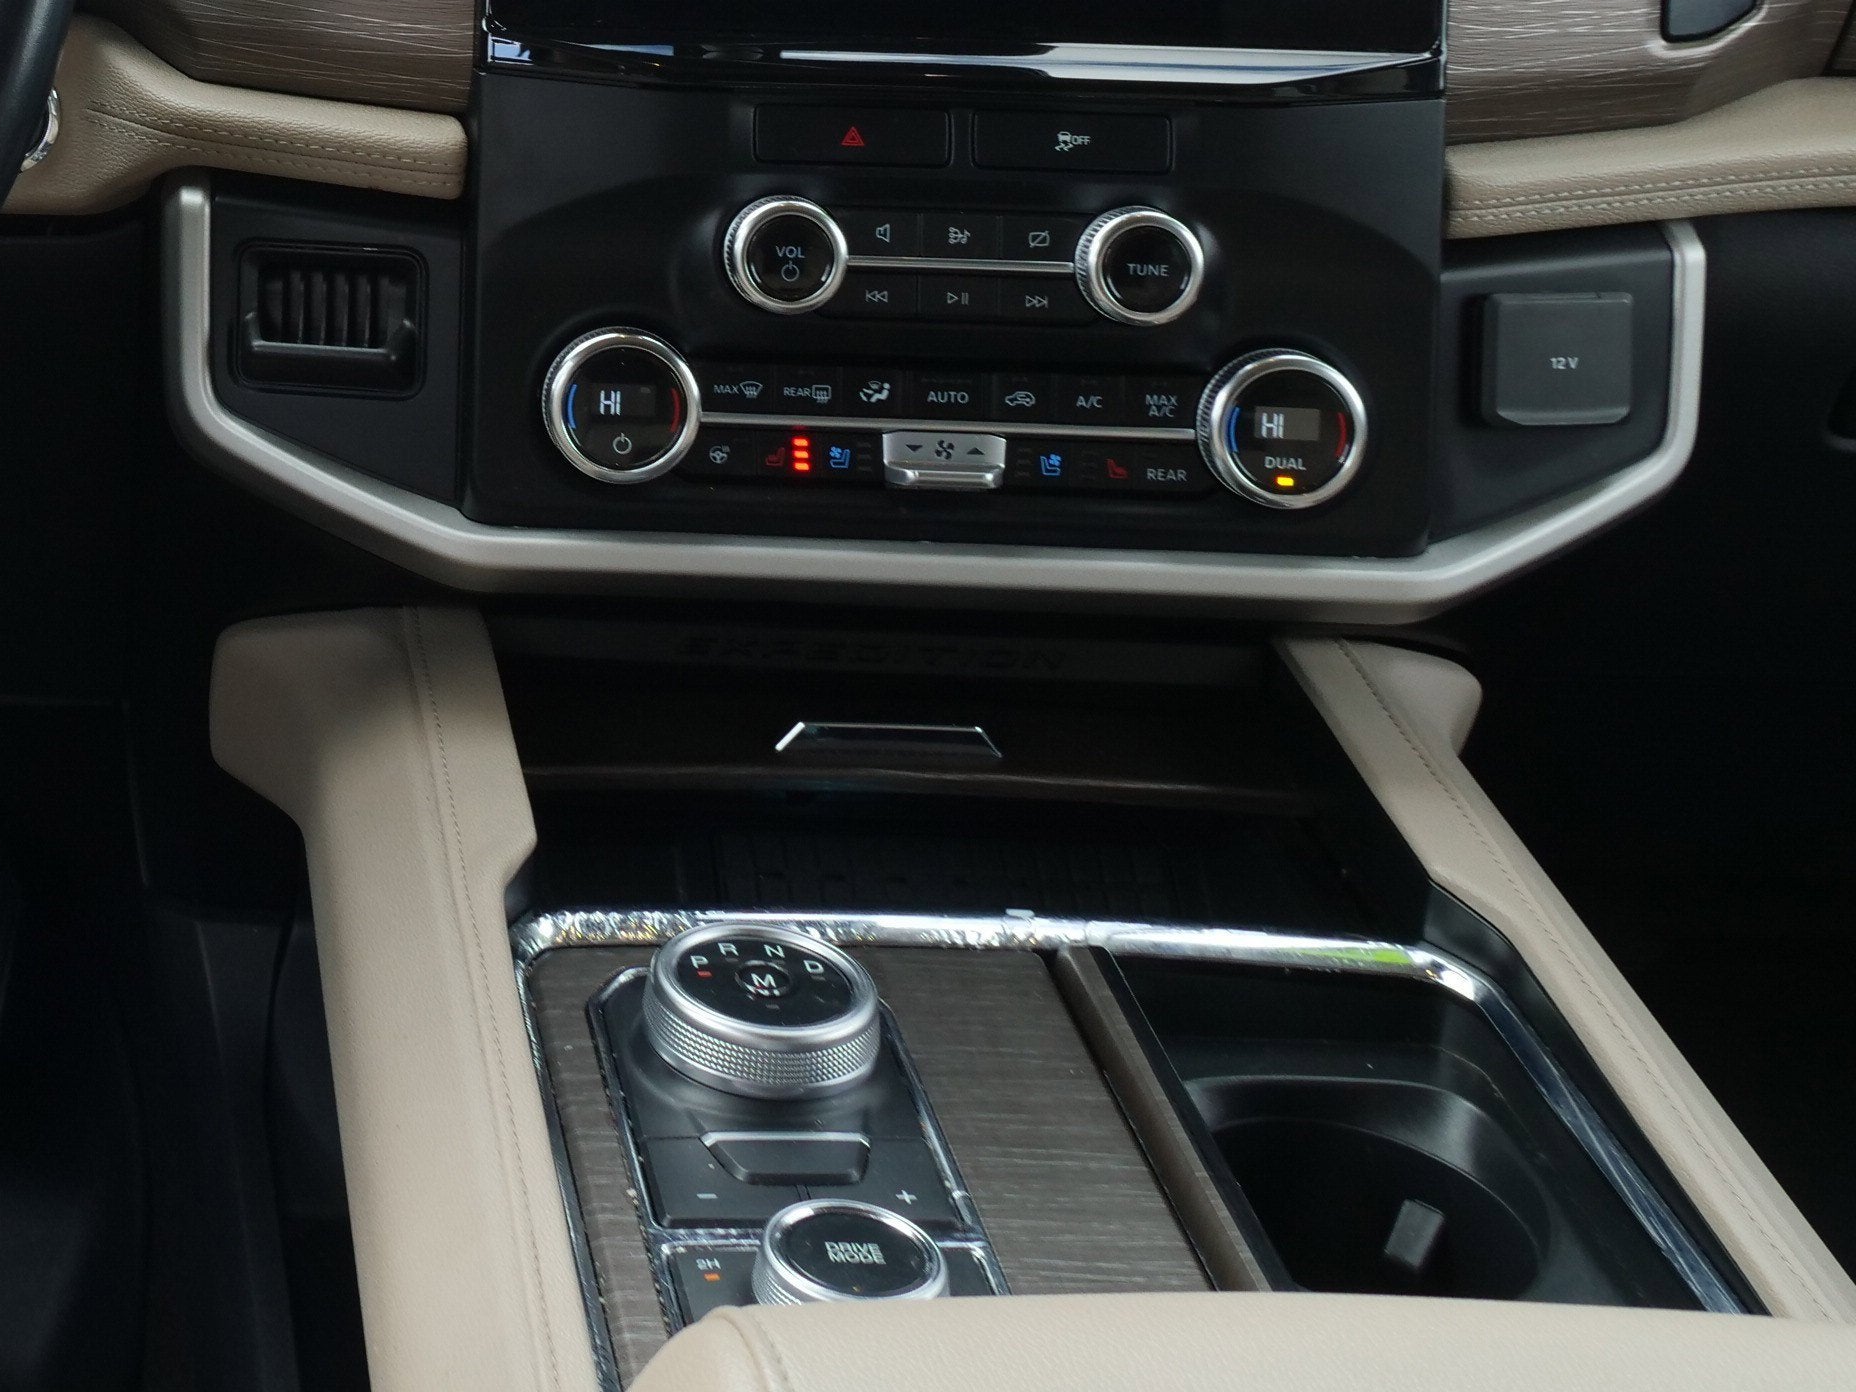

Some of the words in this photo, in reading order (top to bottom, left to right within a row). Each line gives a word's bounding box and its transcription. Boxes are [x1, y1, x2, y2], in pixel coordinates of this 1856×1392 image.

[1071, 134, 1091, 146] OFF
[775, 245, 806, 259] VOL
[1126, 263, 1170, 278] TUNE
[713, 383, 741, 395] MAX
[783, 386, 811, 398] REAR
[599, 390, 622, 416] HI
[926, 390, 970, 405] AUTO
[1076, 394, 1103, 409] A/C
[1145, 394, 1178, 407] MAX
[1148, 406, 1175, 419] A/C
[1261, 412, 1285, 439] HI
[1264, 456, 1307, 471] DUAL
[1147, 468, 1188, 483] REAR
[718, 943, 739, 957] R
[763, 944, 786, 959] N
[690, 955, 709, 970] P
[803, 960, 825, 974] D
[750, 973, 777, 988] M
[824, 1241, 882, 1256] DRIVE
[828, 1251, 886, 1265] MODE
